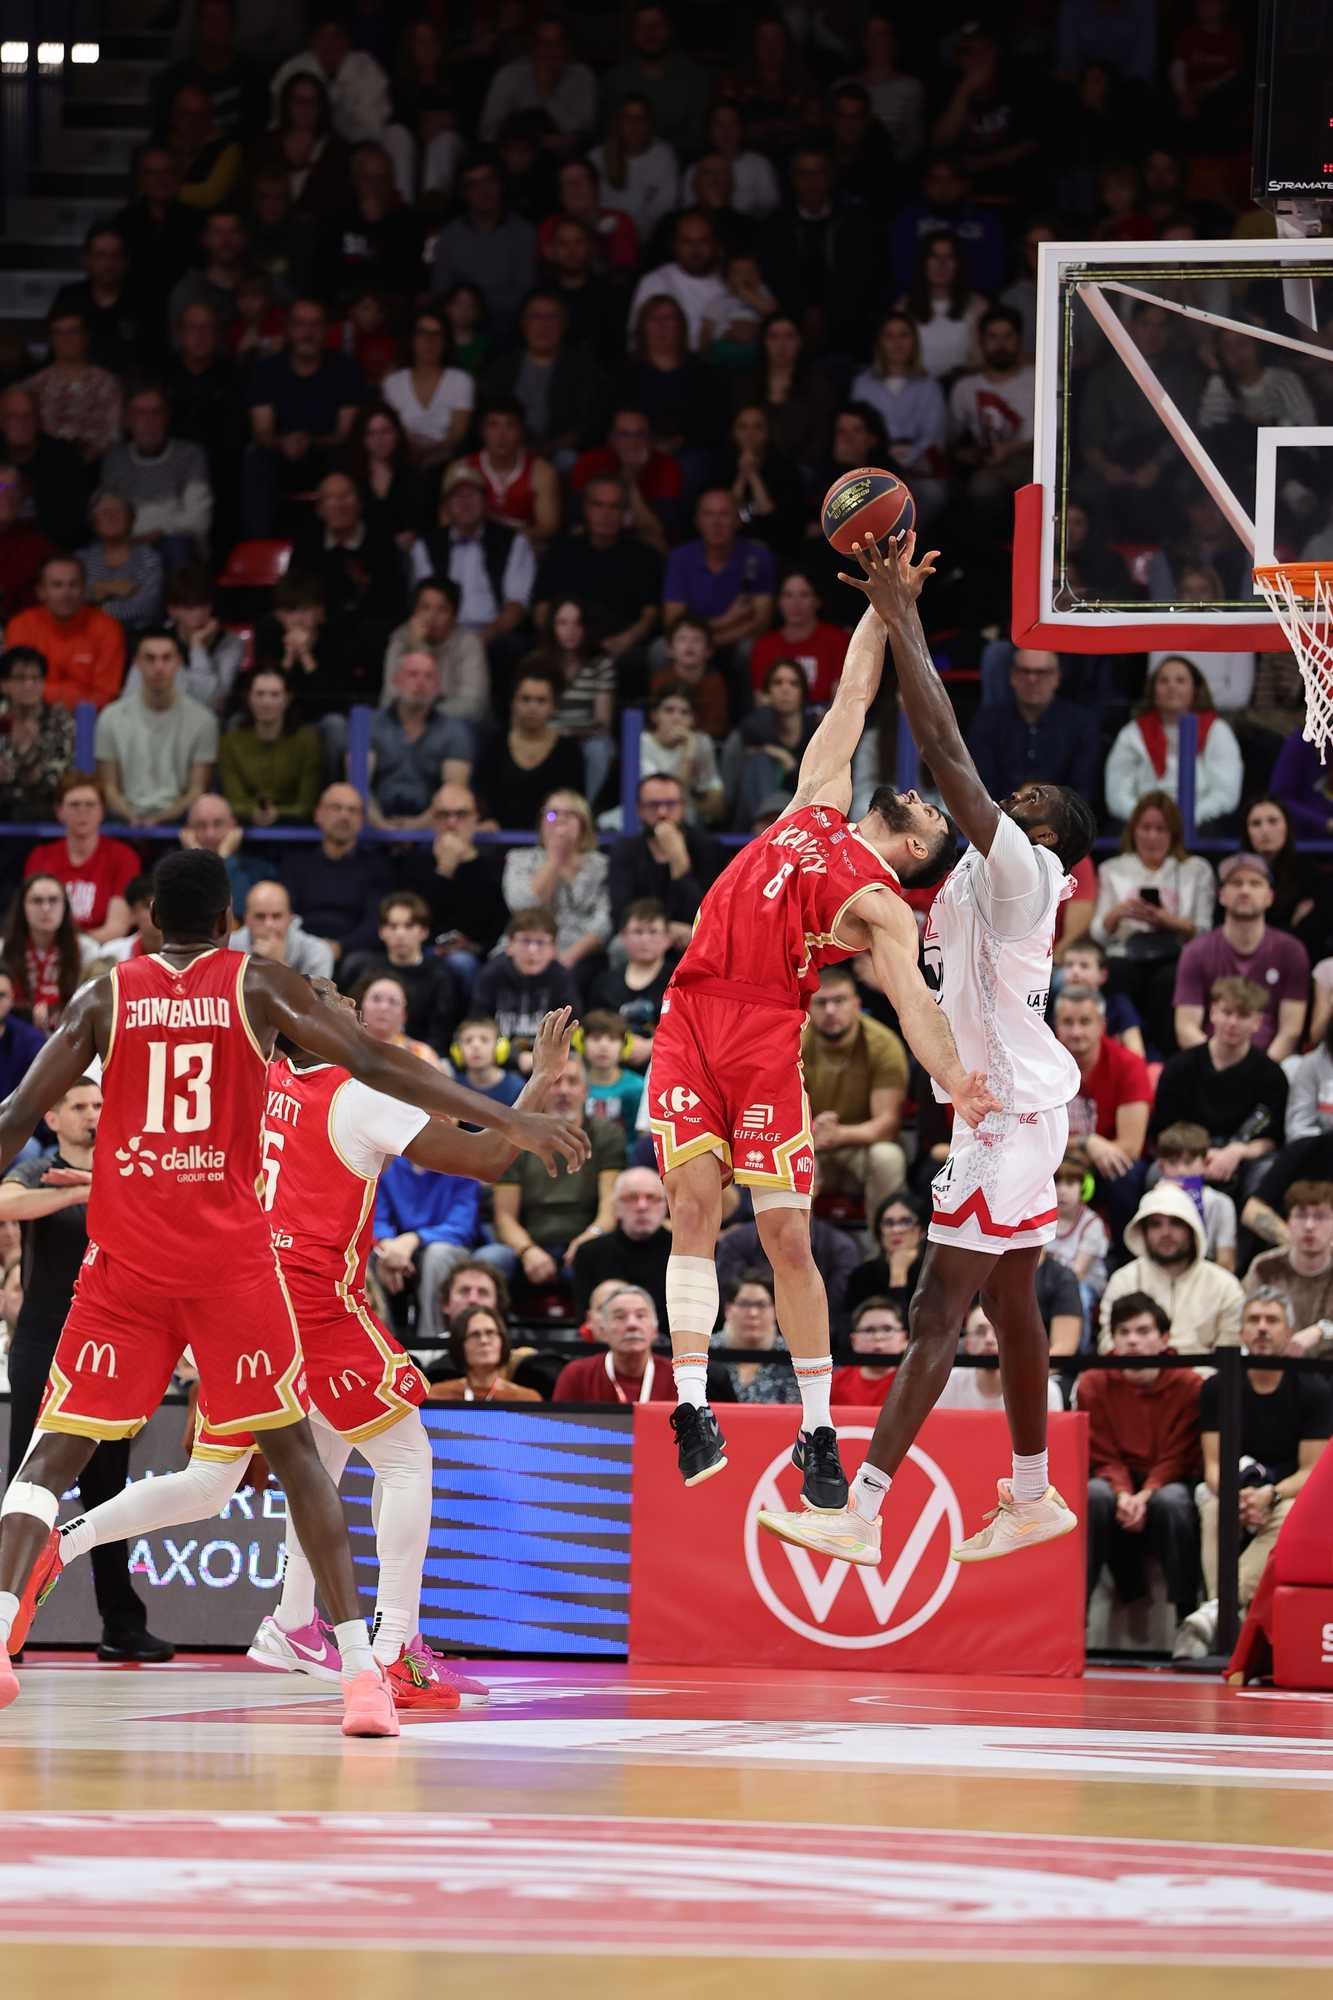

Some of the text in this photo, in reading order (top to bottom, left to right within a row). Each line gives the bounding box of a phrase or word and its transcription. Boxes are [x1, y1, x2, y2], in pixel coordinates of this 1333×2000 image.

[1267, 180, 1333, 192] STRAMATE
[142, 1041, 214, 1134] 13
[266, 1090, 302, 1127] YATT
[733, 1129, 782, 1142] EIFFAGE
[161, 1145, 225, 1171] dalkia
